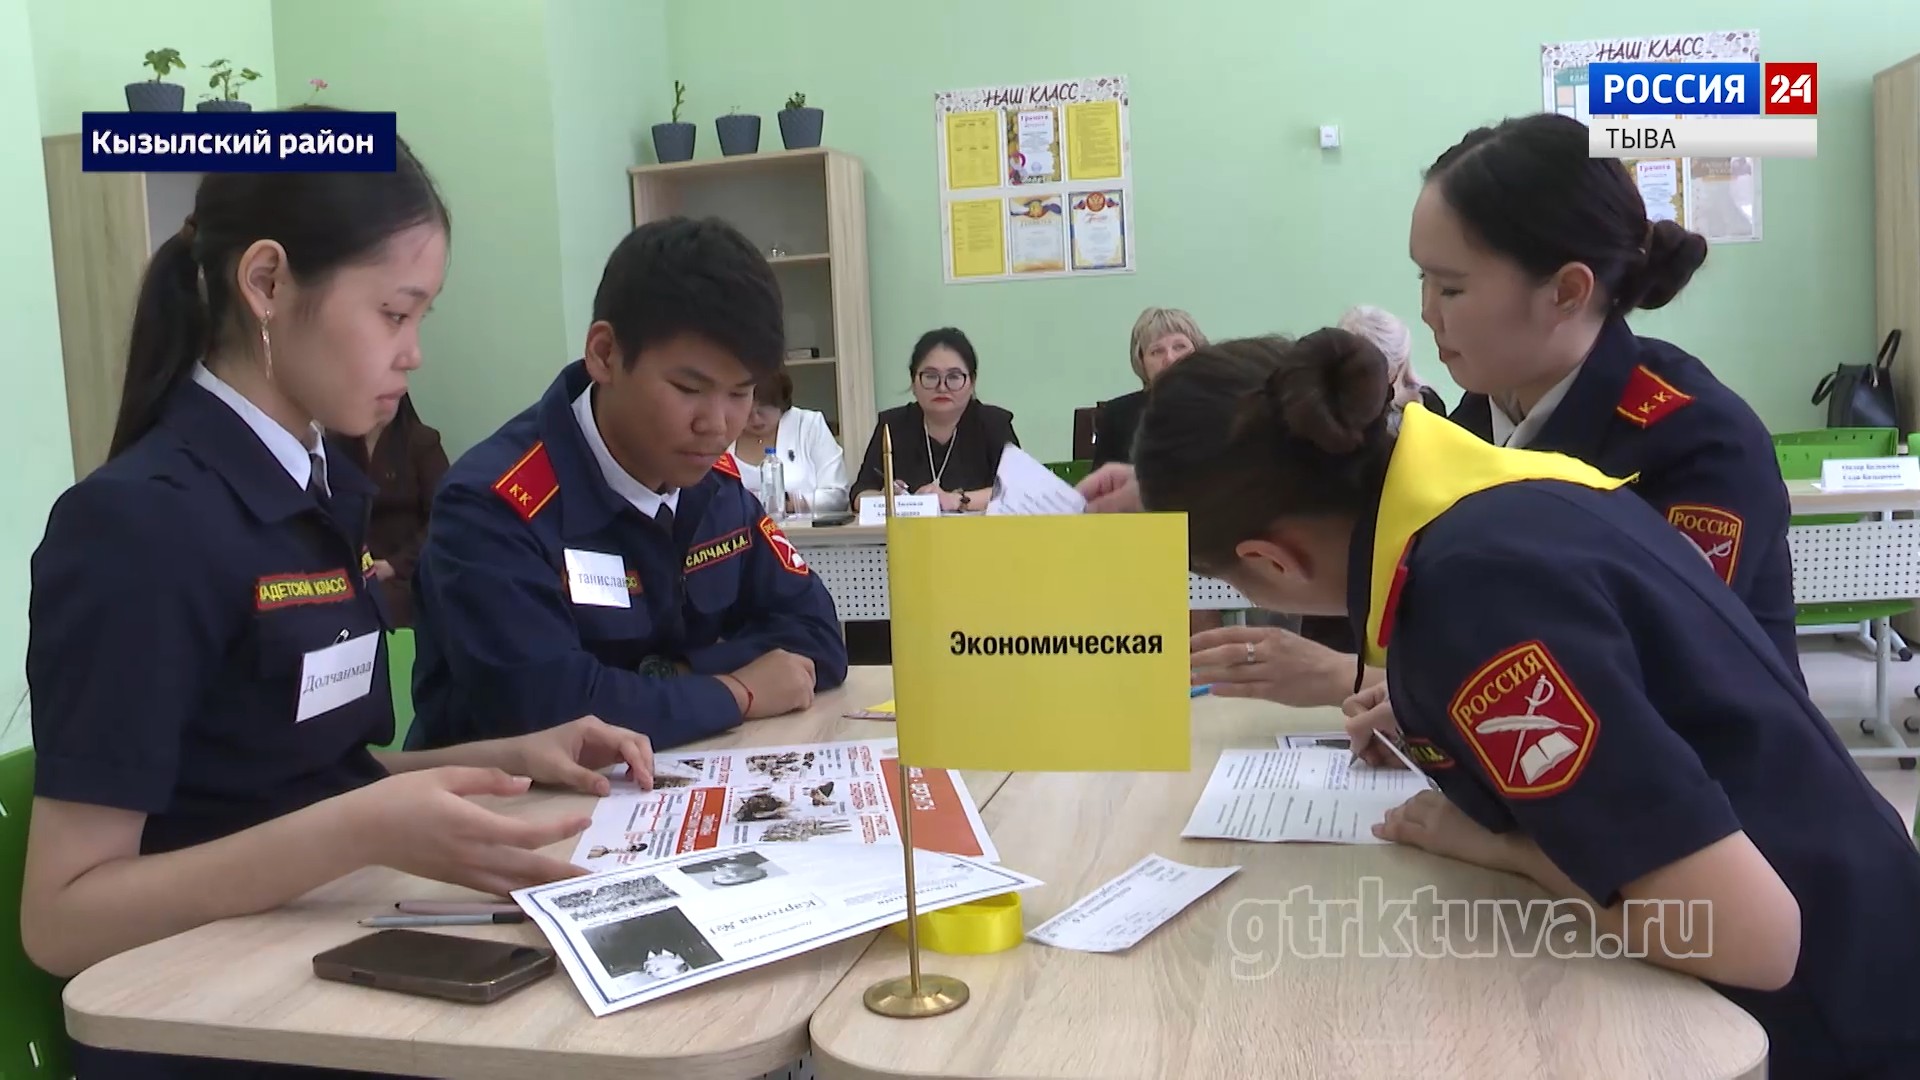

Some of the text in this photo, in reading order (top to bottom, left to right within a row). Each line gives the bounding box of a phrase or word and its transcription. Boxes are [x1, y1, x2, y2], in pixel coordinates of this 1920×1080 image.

[1596, 37, 1704, 62] НАШ КЛАСС
[984, 83, 1079, 107] НАШ КЛАСС
[1674, 511, 1738, 537] РОССИЯ
[685, 541, 732, 567] САЛЧАК
[949, 630, 1163, 656] Экономическая
[302, 661, 372, 693] Долчанмаа
[1458, 651, 1544, 726] РОССИЯ
